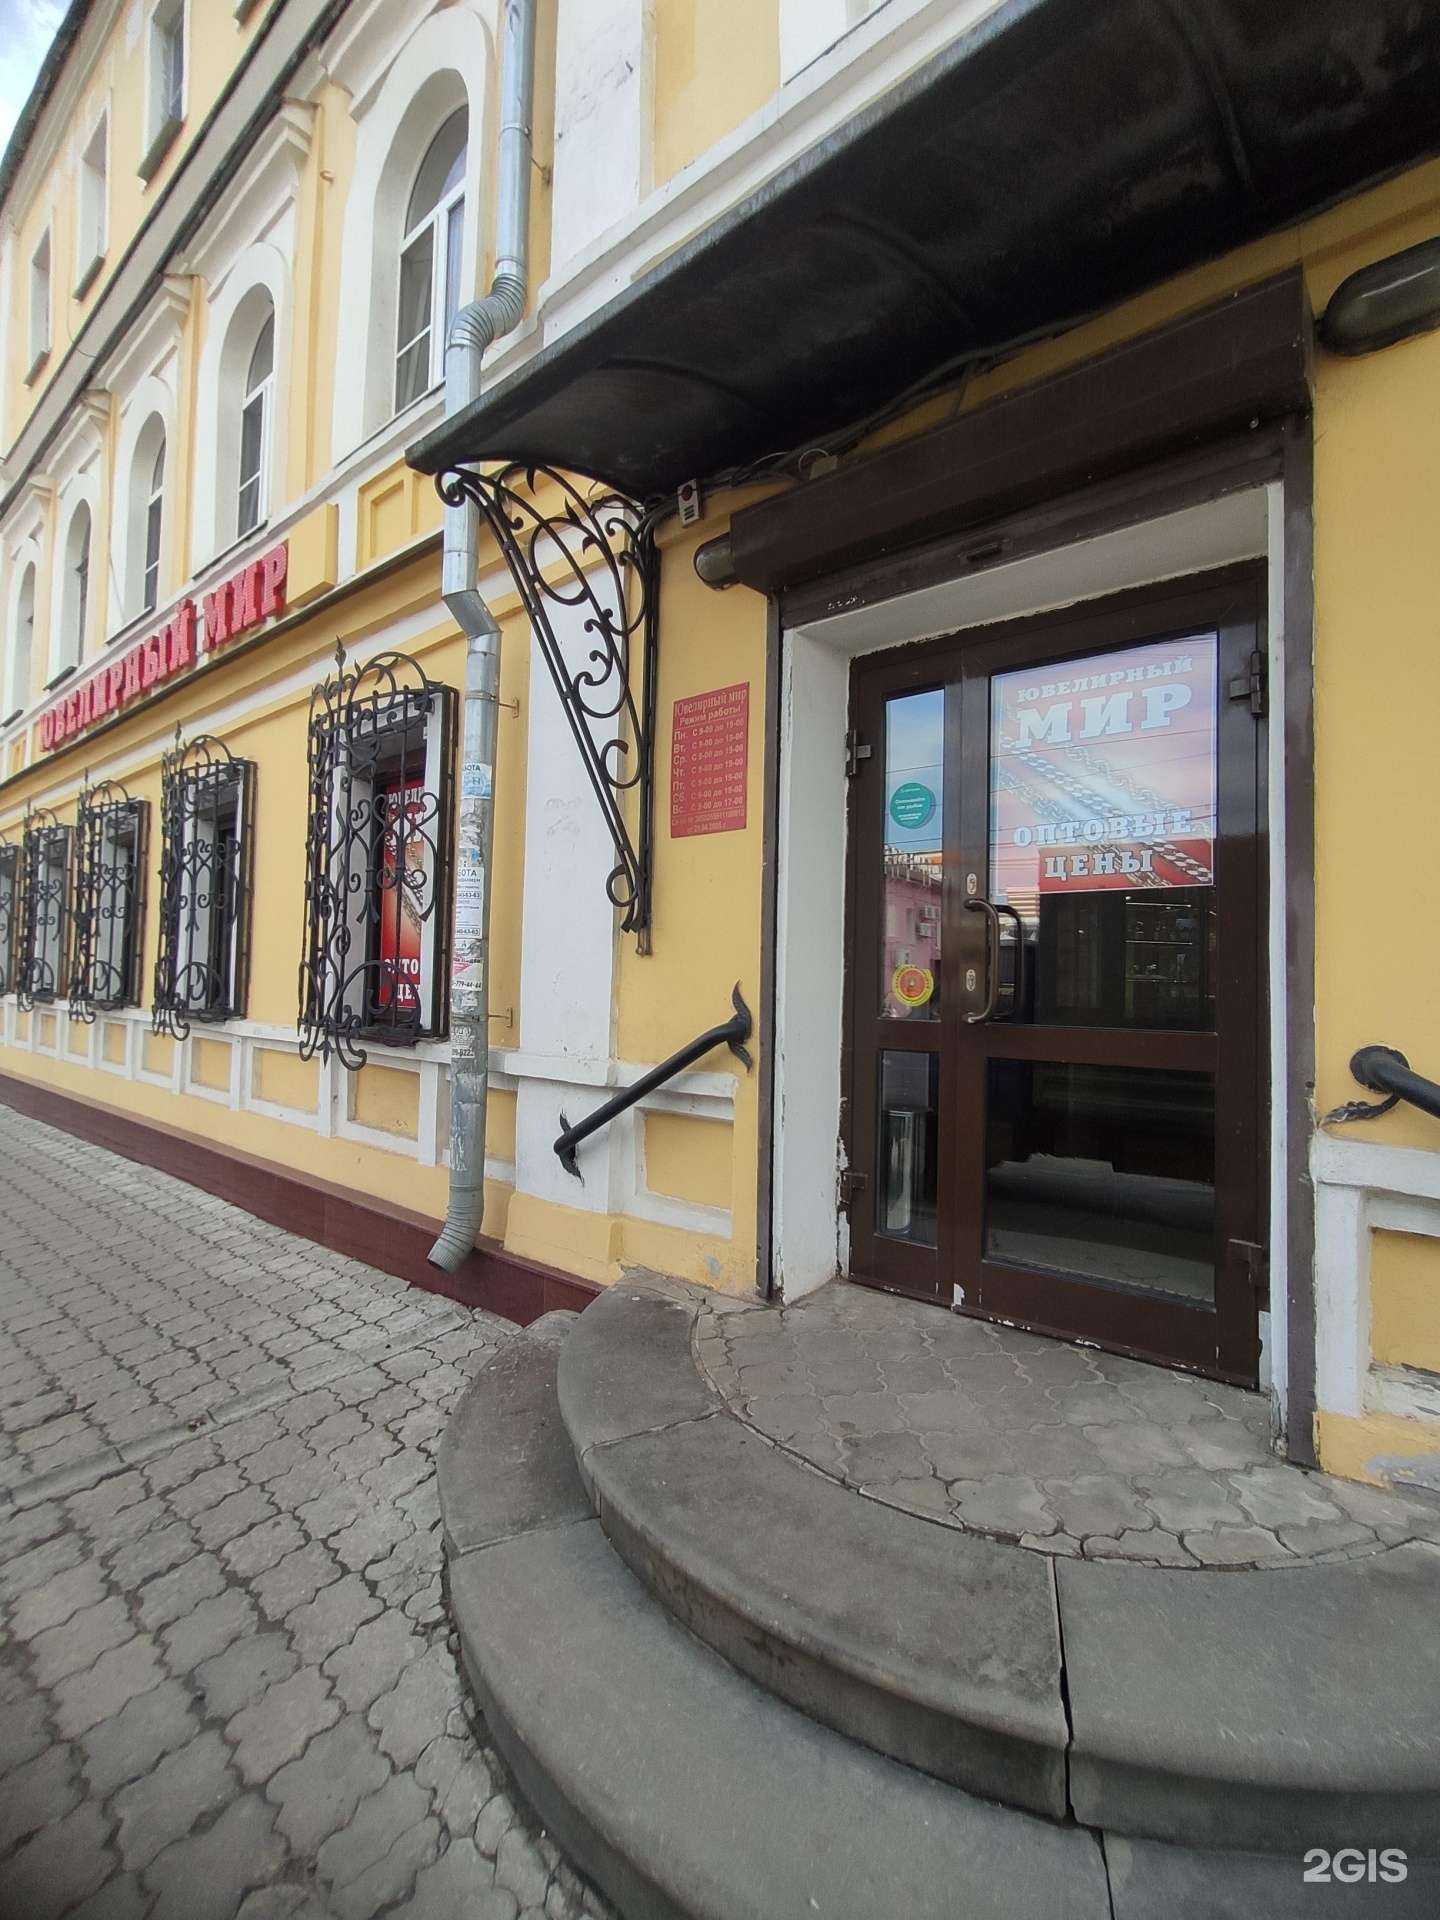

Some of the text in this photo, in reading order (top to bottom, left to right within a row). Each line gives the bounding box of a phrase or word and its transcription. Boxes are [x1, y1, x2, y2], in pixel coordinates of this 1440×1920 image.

[40, 541, 288, 751] ЮВЕЛИРНЫЙ МИР
[1016, 655, 1193, 702] ЮВЕЛИРНЫЙ
[708, 704, 741, 721] работы
[1014, 683, 1192, 749] МИР
[1014, 808, 1193, 847] ОПТОВЫЕ
[1045, 850, 1154, 882] ЦЕНЫ
